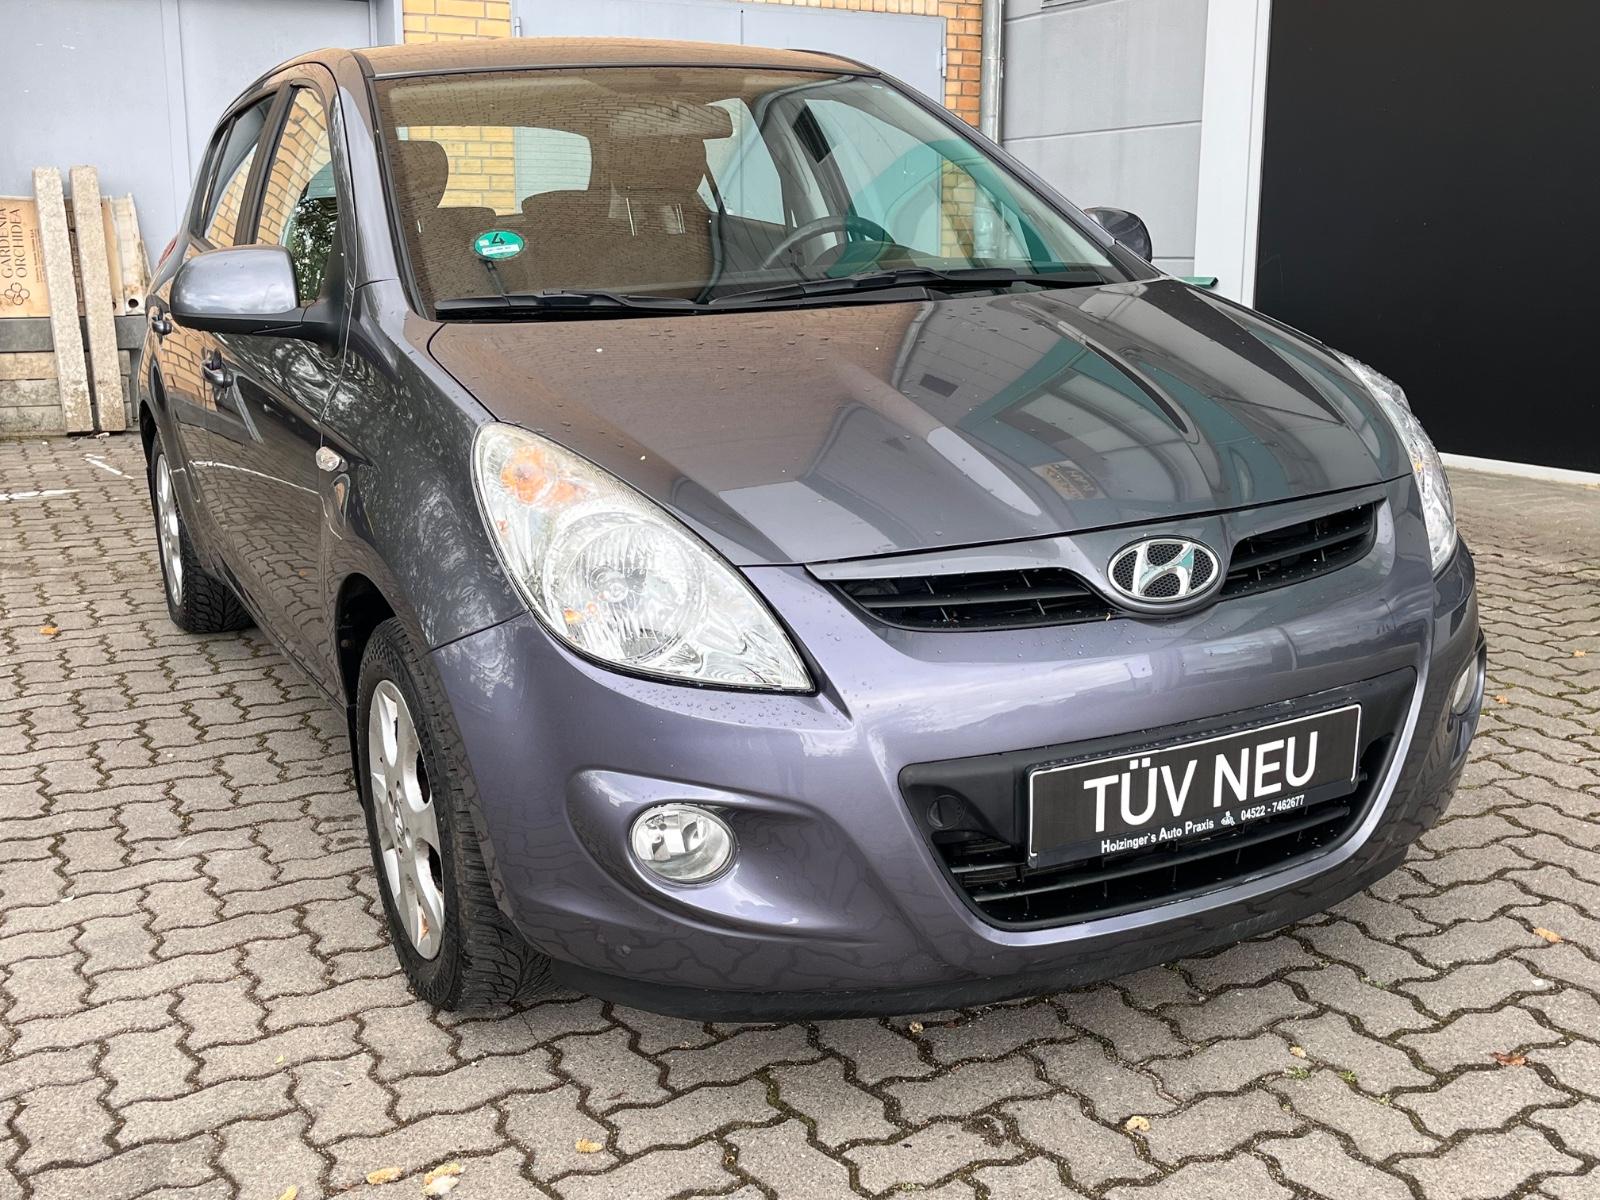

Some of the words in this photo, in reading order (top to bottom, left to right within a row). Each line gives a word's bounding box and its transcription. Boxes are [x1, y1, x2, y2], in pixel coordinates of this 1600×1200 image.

[9, 208, 28, 278] ORCHIDEA
[491, 232, 505, 245] 4
[1083, 757, 1198, 833] TÜV
[1213, 731, 1319, 808] NEU
[1159, 827, 1183, 841] Auto
[1185, 818, 1215, 835] Praxis
[1240, 805, 1266, 821] 04522
[1272, 794, 1305, 813] 7462677
